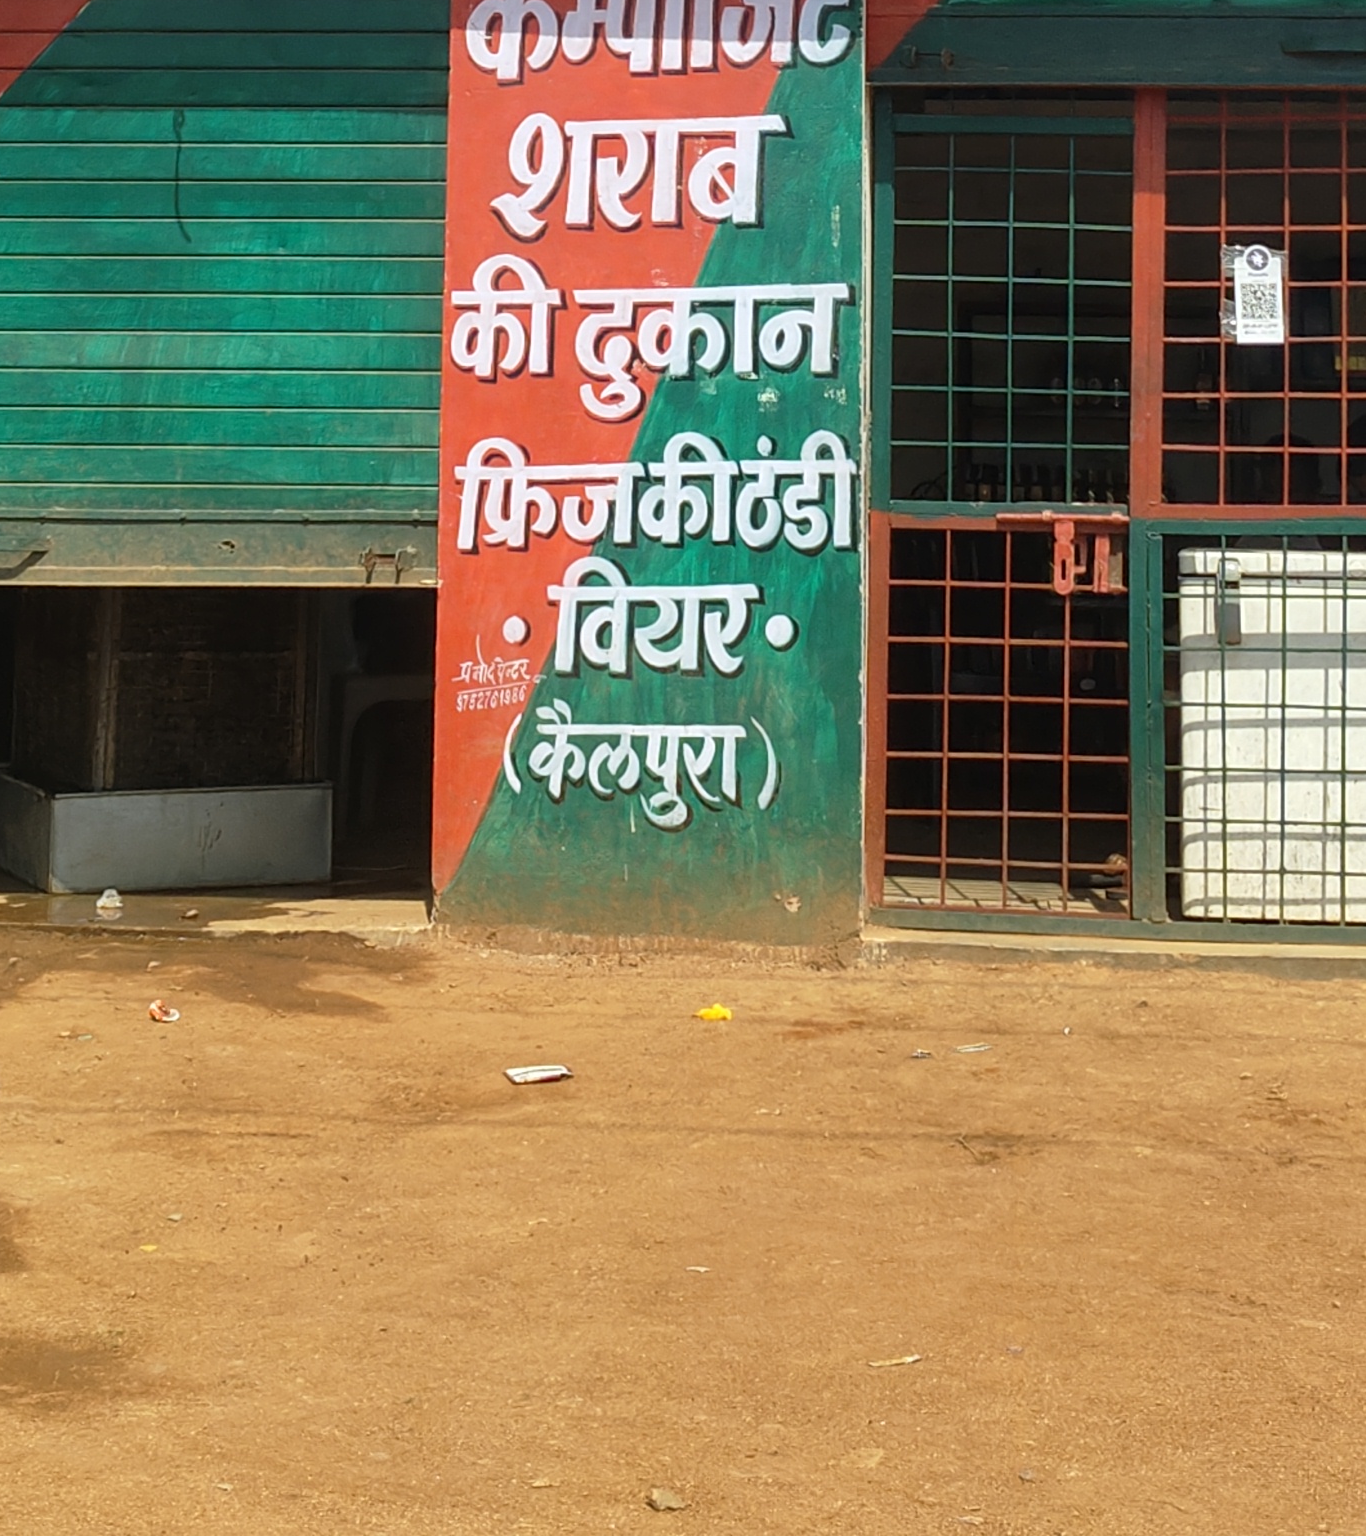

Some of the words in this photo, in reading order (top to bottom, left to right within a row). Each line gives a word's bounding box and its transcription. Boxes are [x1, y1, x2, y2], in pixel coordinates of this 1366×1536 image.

[490, 112, 787, 238] शराब
[450, 253, 562, 377] की
[573, 282, 850, 421] दुकान
[547, 556, 759, 675] वियर
